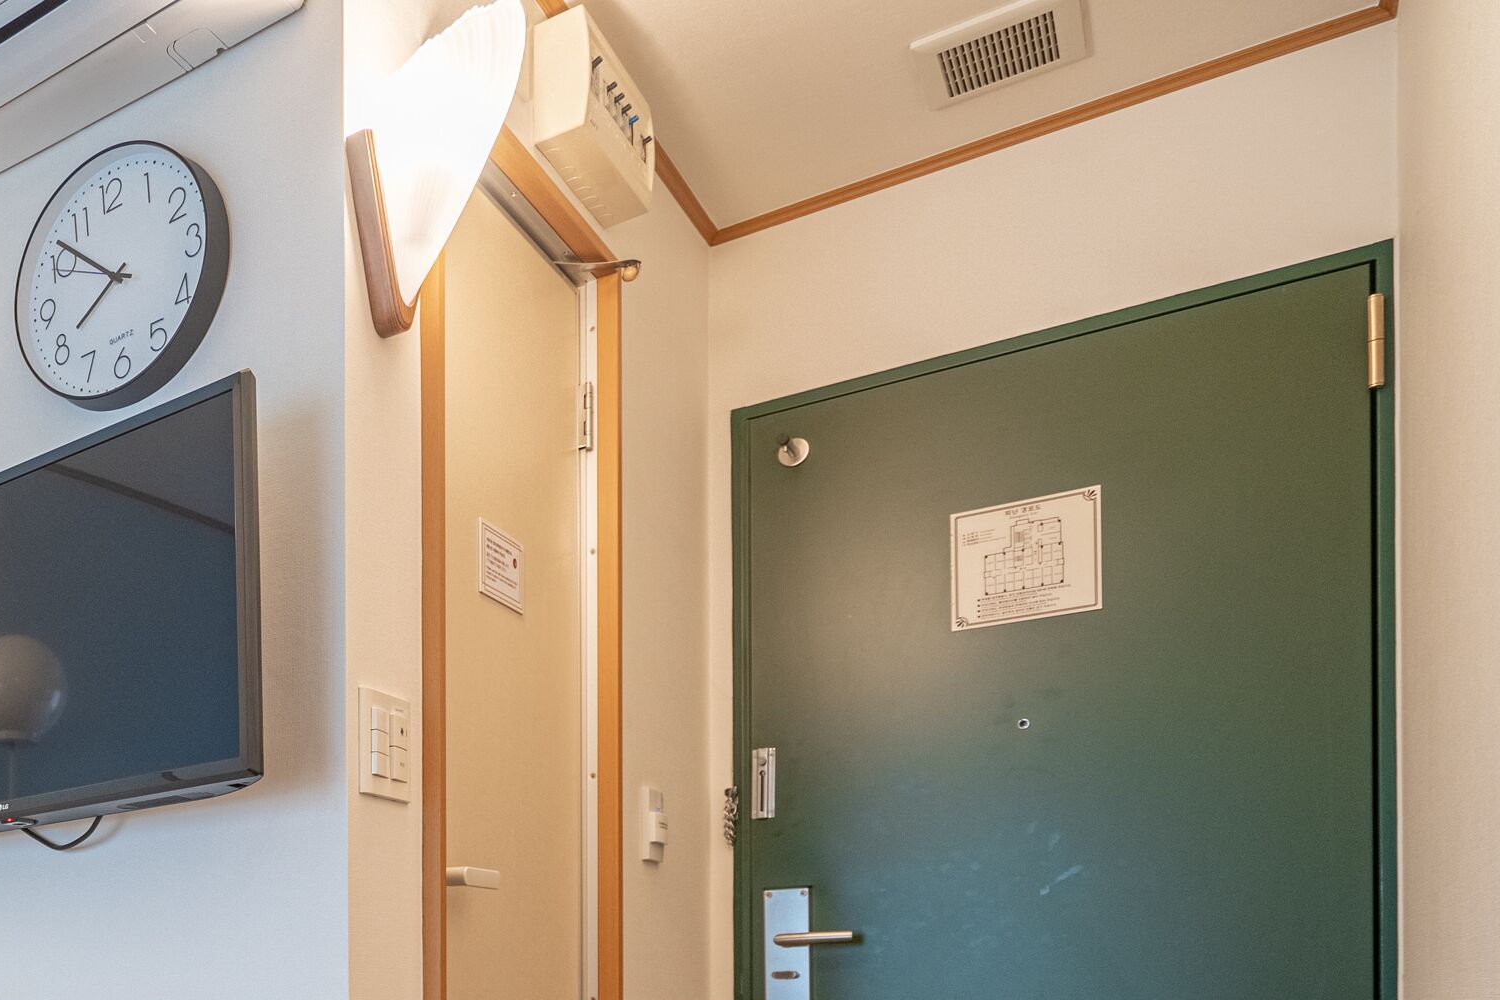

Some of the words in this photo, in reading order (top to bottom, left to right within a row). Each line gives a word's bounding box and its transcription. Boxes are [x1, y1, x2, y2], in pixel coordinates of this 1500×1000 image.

[99, 177, 123, 215] 12
[143, 172, 151, 203] 1
[168, 186, 187, 224] 2
[72, 206, 90, 242] 11
[184, 222, 202, 258] 3
[50, 247, 77, 284] 10
[174, 272, 192, 305] 4
[39, 298, 56, 330] 9
[54, 333, 70, 366] 8
[109, 328, 134, 345] QUARTZ
[149, 318, 167, 352] 5
[80, 350, 96, 383] 7
[113, 346, 132, 379] 6
